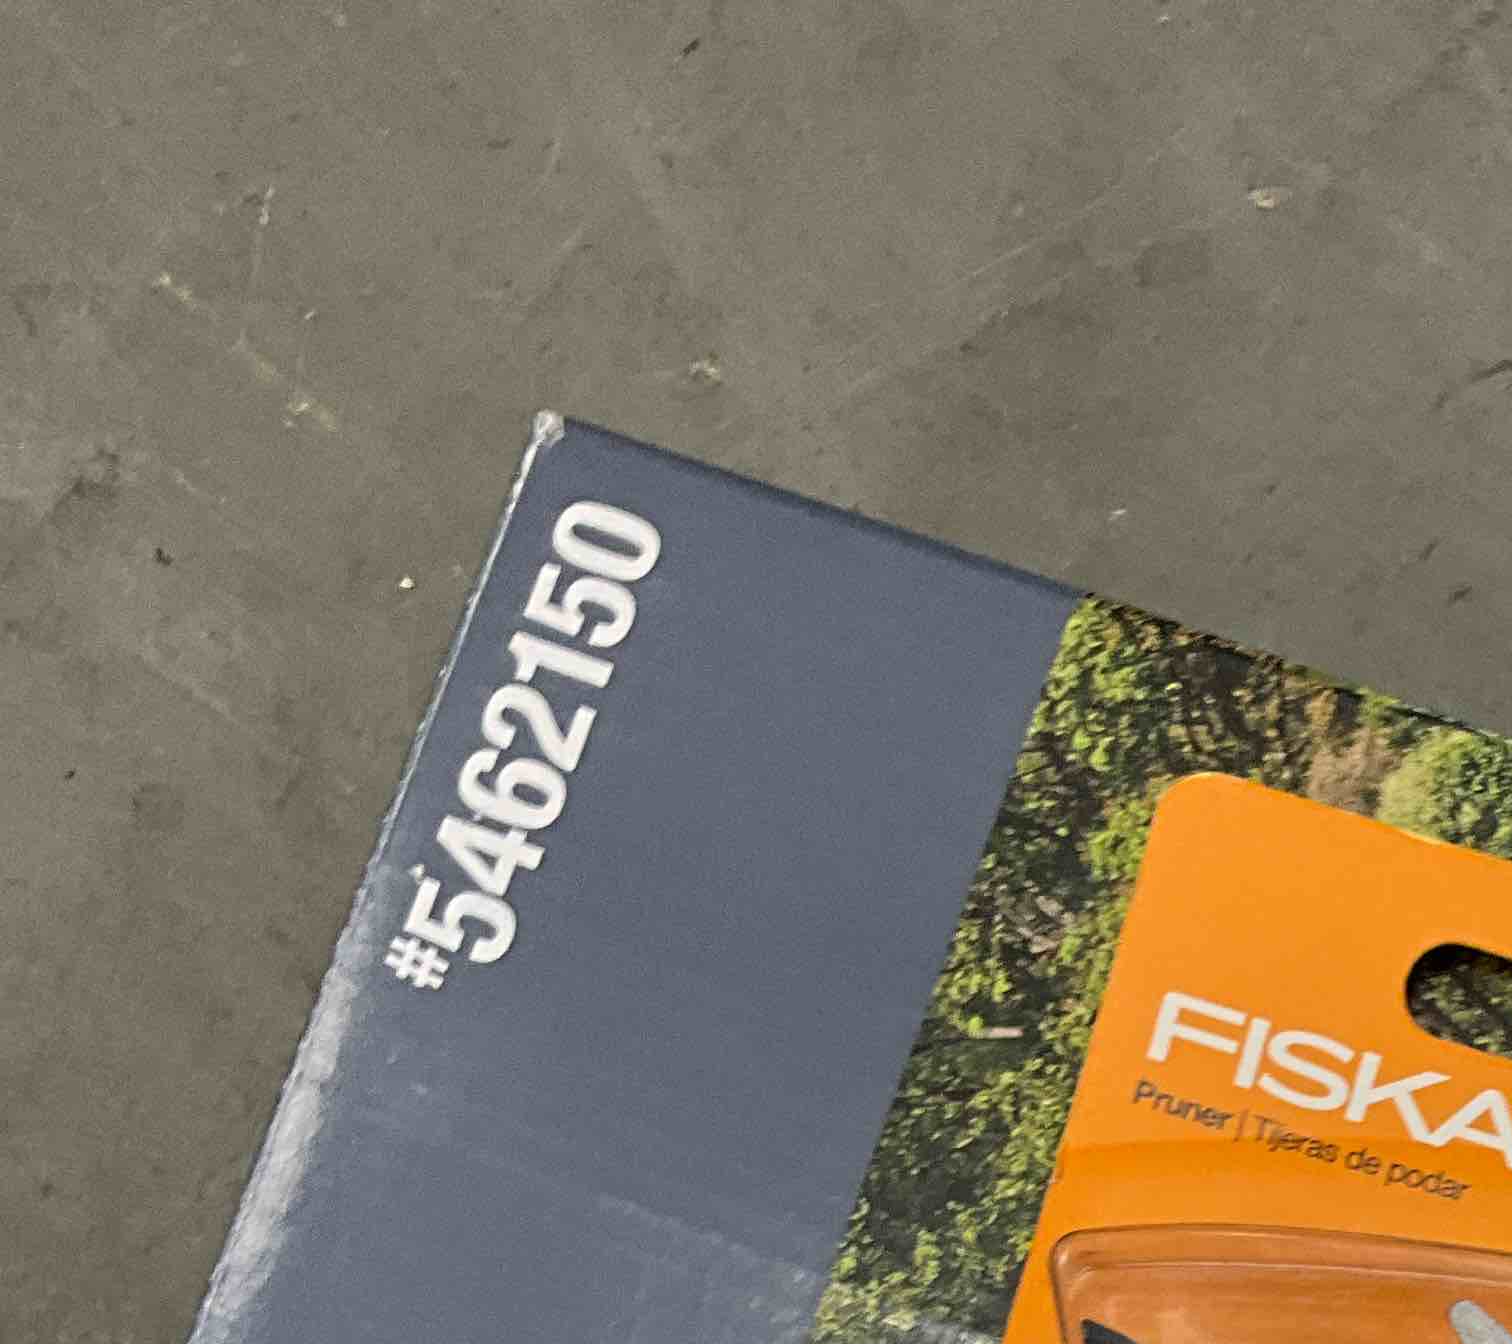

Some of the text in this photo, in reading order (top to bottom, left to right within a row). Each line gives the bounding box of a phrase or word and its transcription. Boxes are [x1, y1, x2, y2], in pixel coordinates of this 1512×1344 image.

[383, 500, 661, 991] #5462150
[1133, 1079, 1232, 1130] Pruner
[1251, 1114, 1338, 1163] Tijeras
[1343, 1148, 1381, 1176] de
[1383, 1161, 1472, 1200] podar
